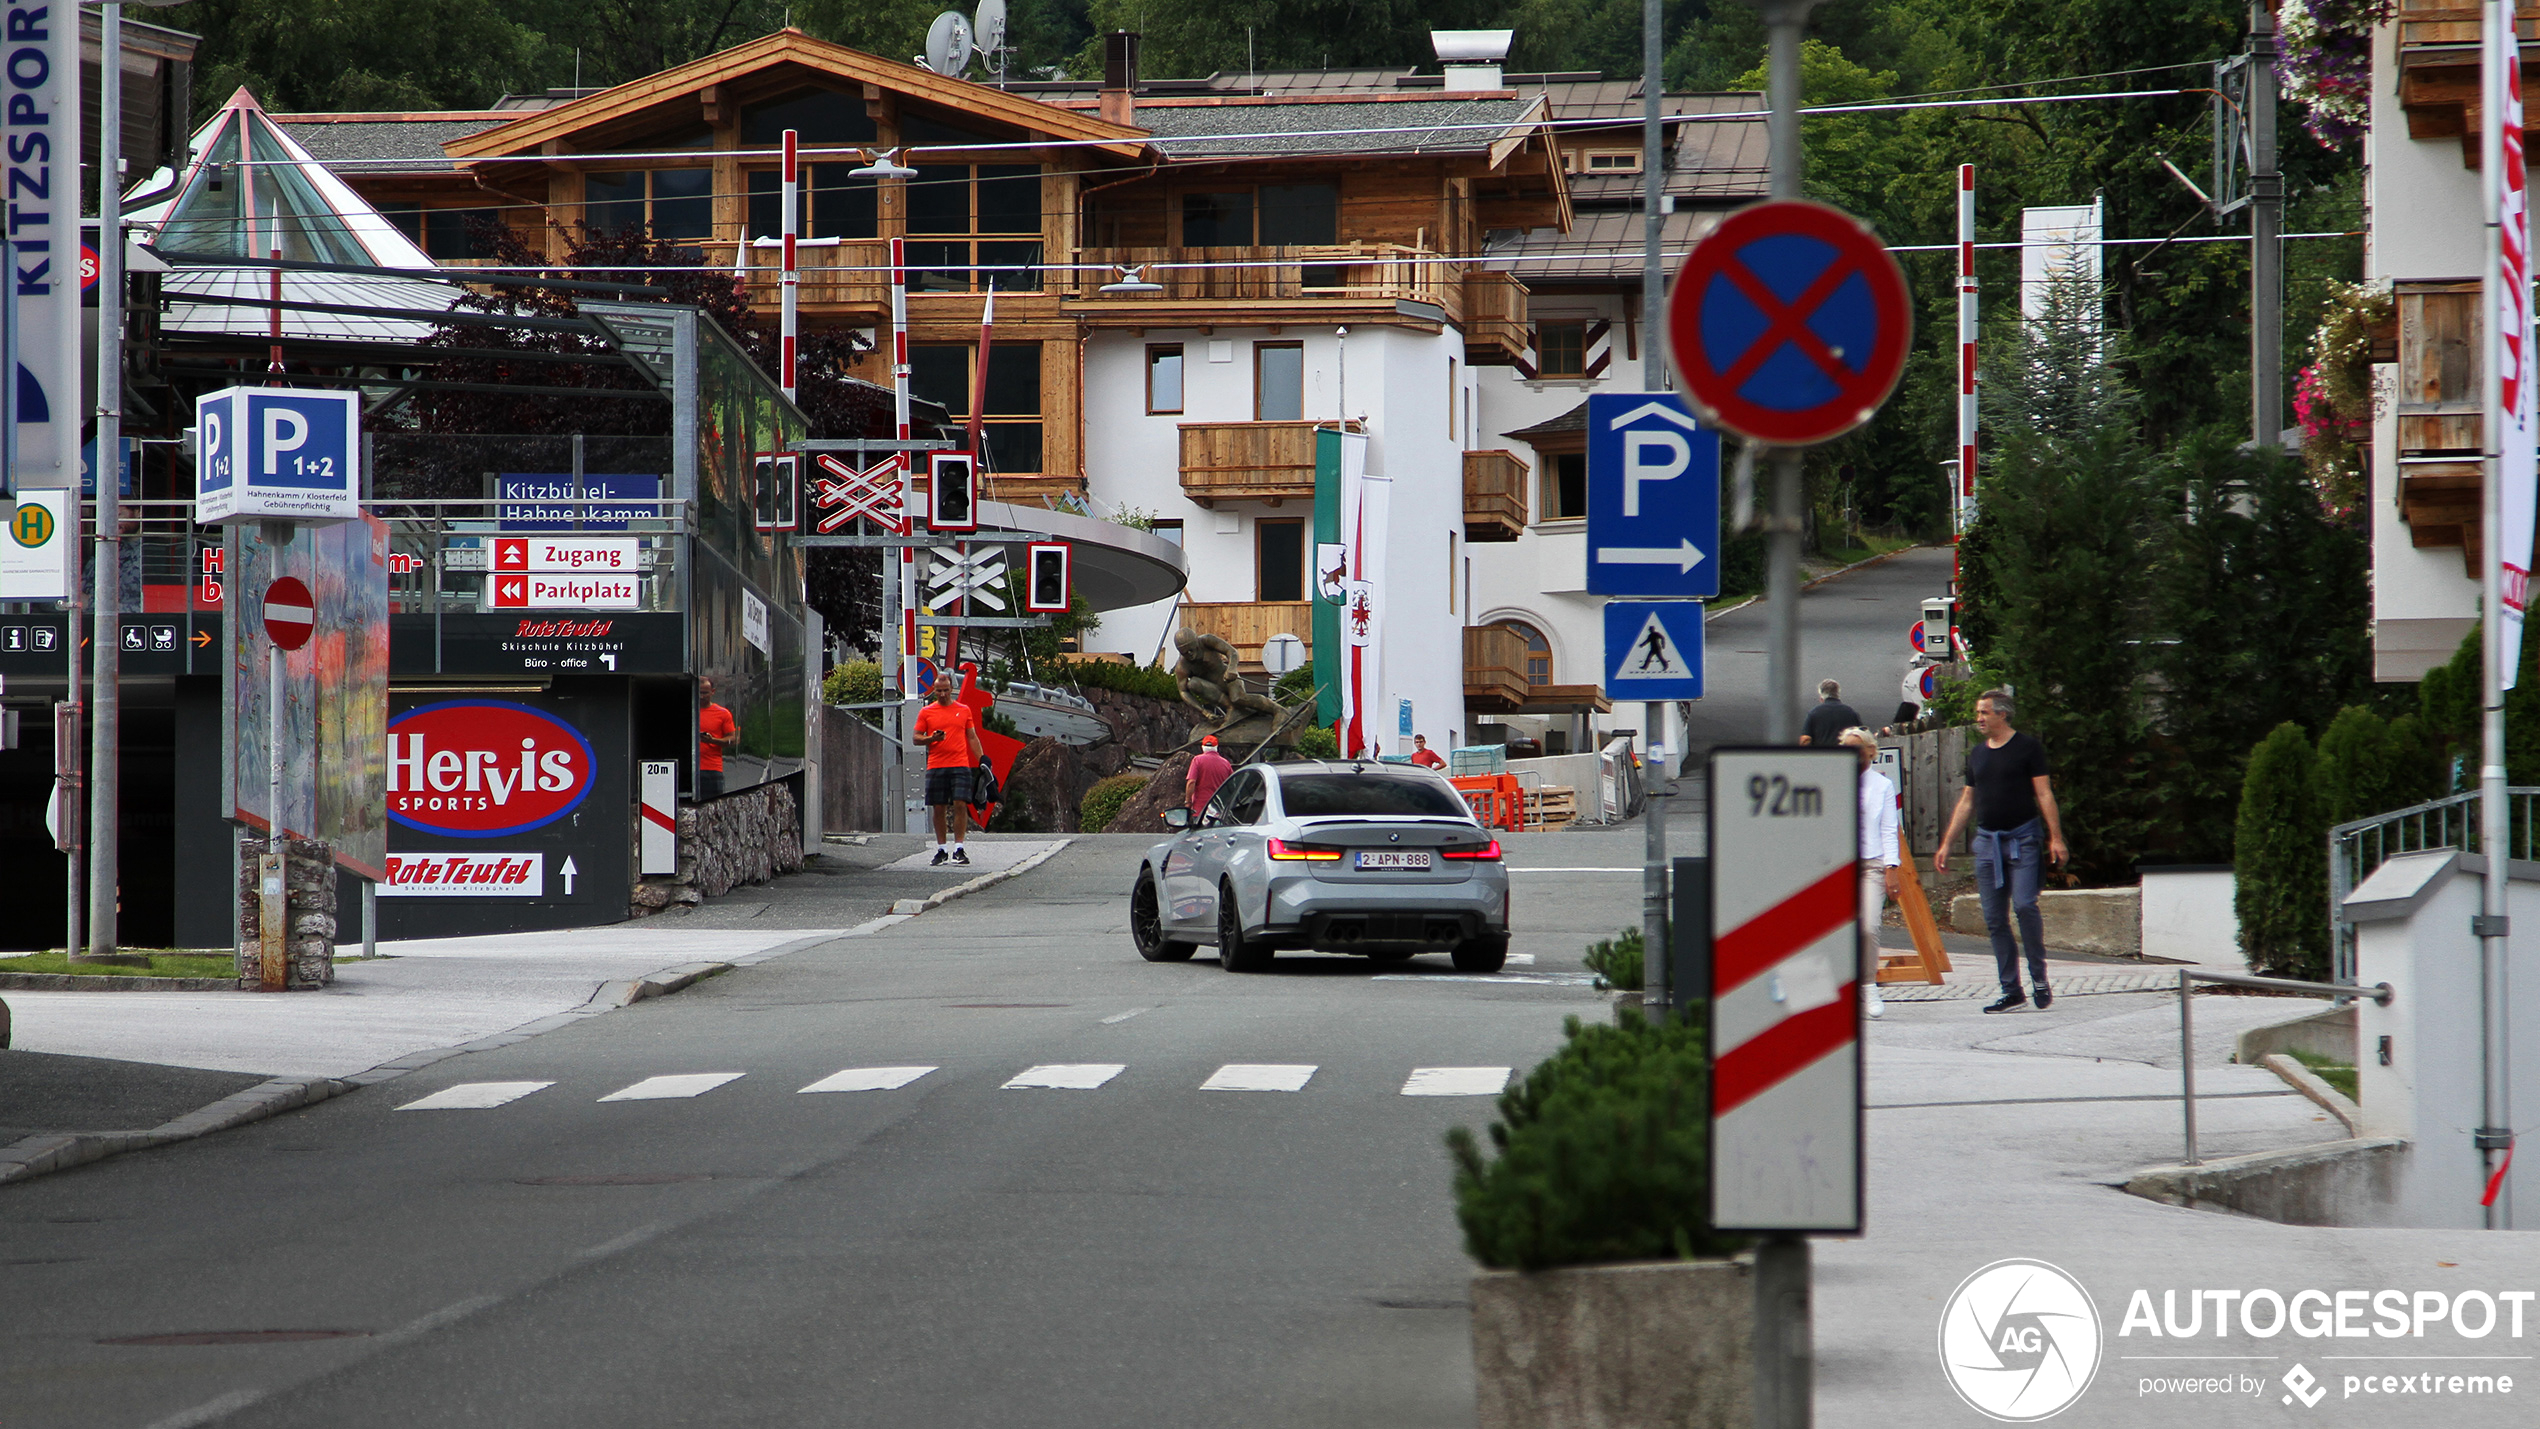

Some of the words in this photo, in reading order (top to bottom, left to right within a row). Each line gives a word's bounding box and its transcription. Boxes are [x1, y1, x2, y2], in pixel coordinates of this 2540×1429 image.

[7, 0, 49, 295] KITZSPOR
[205, 412, 221, 480] P
[263, 407, 308, 475] P
[215, 455, 229, 478] 1+2
[293, 455, 334, 477] 1+2
[1623, 430, 1691, 517] P
[247, 490, 300, 500] Hahnenkamm
[306, 492, 347, 501] Klosterfeld
[263, 500, 331, 512] Gebührenpflichtig
[21, 511, 43, 540] H
[545, 546, 621, 568] Zugang
[534, 580, 632, 604] Parkplatz
[501, 642, 560, 651] Skischule
[566, 641, 624, 651] Kitzbühel
[524, 657, 548, 668] Büro
[560, 657, 588, 668] office
[387, 733, 575, 806] Hervis
[398, 796, 488, 811] SPORTS
[1747, 773, 1823, 818] 92m
[1363, 854, 1429, 866] 2-APN-888
